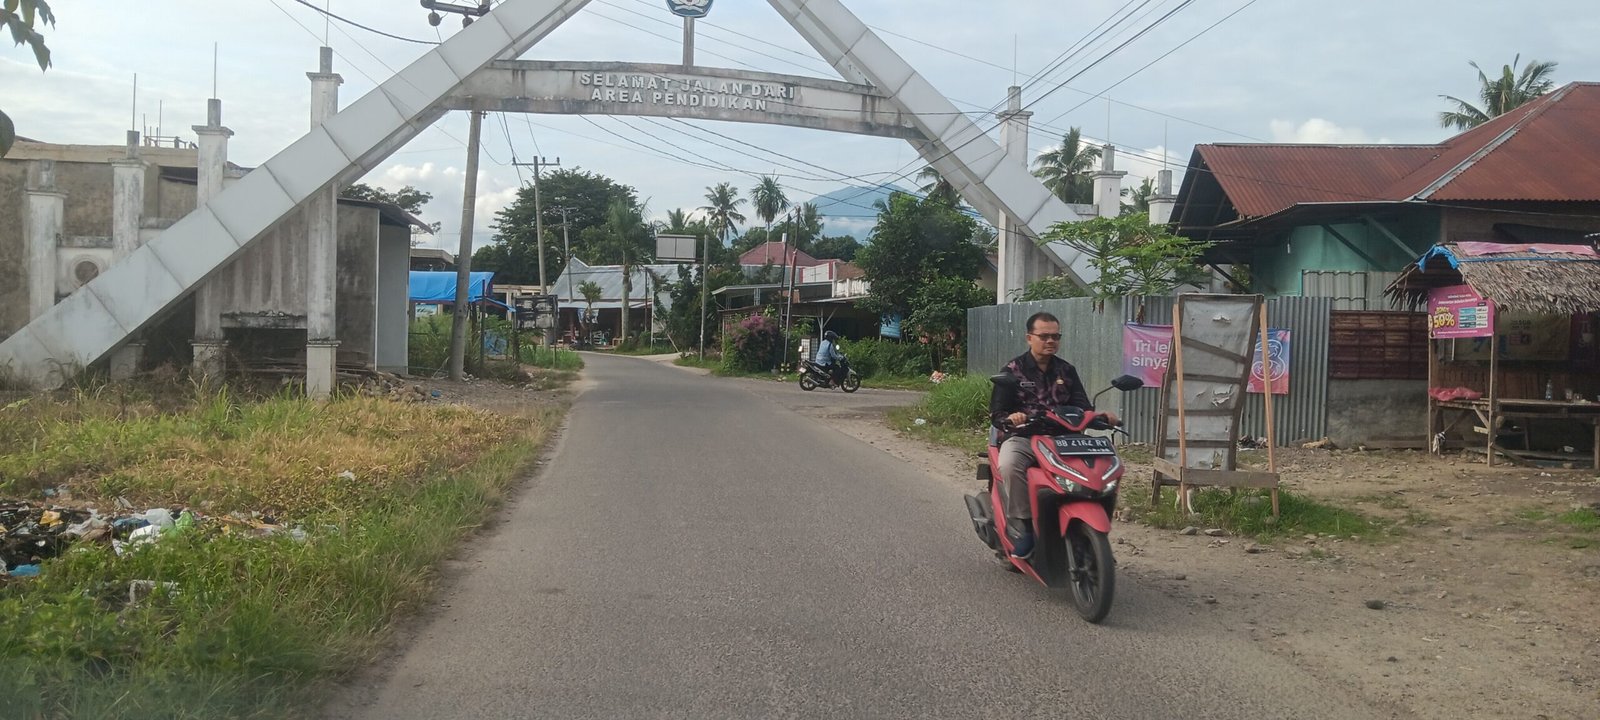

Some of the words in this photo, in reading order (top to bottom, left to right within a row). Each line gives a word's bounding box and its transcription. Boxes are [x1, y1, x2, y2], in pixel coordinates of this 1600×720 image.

[581, 73, 671, 90] SELAMAT
[681, 79, 742, 94] JALAN
[751, 83, 794, 99] DARI
[592, 88, 643, 103] AREA
[653, 91, 766, 111] PENDIDIKAN
[1433, 313, 1455, 328] 50%
[1132, 339, 1151, 352] Tri
